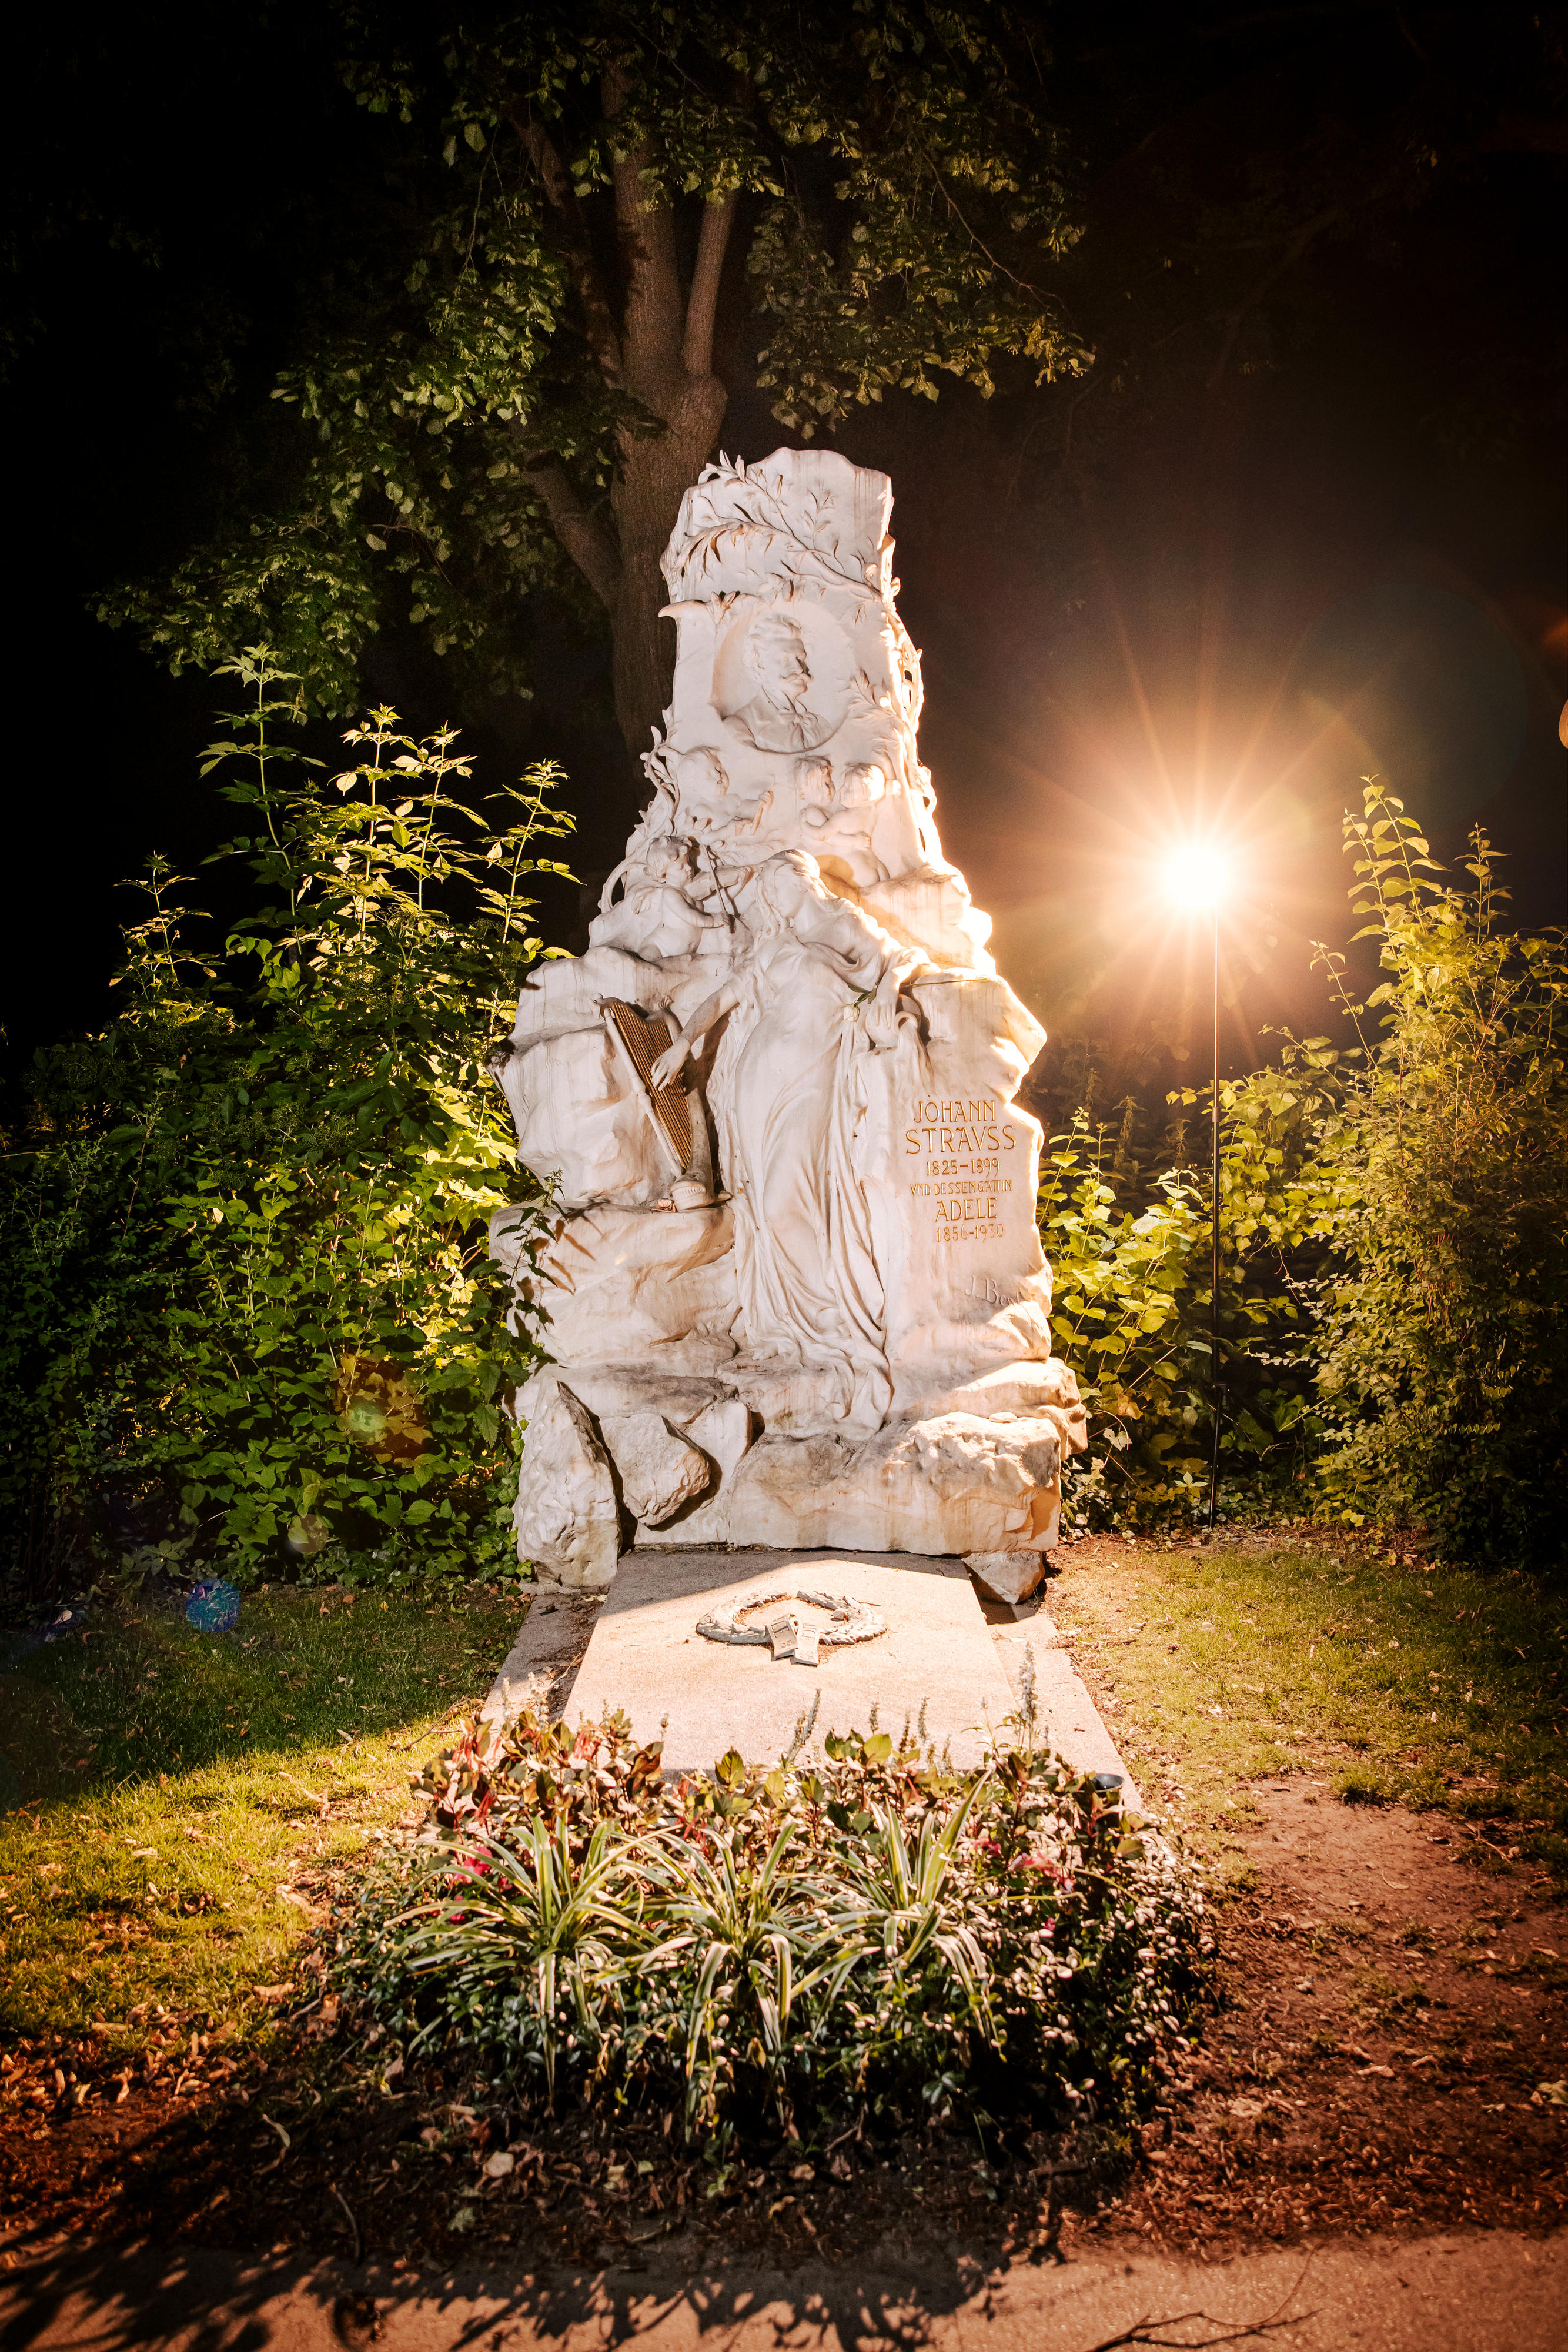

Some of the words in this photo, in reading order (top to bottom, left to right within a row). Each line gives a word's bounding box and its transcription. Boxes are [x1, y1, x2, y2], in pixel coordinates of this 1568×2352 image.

[914, 1100, 995, 1123] JOHANN
[905, 1125, 1017, 1154] STRAVSS
[910, 1182, 931, 1196] VND
[934, 1180, 977, 1195] DESSEN
[978, 1179, 1012, 1194] GATTIN
[935, 1197, 998, 1222] ADELE
